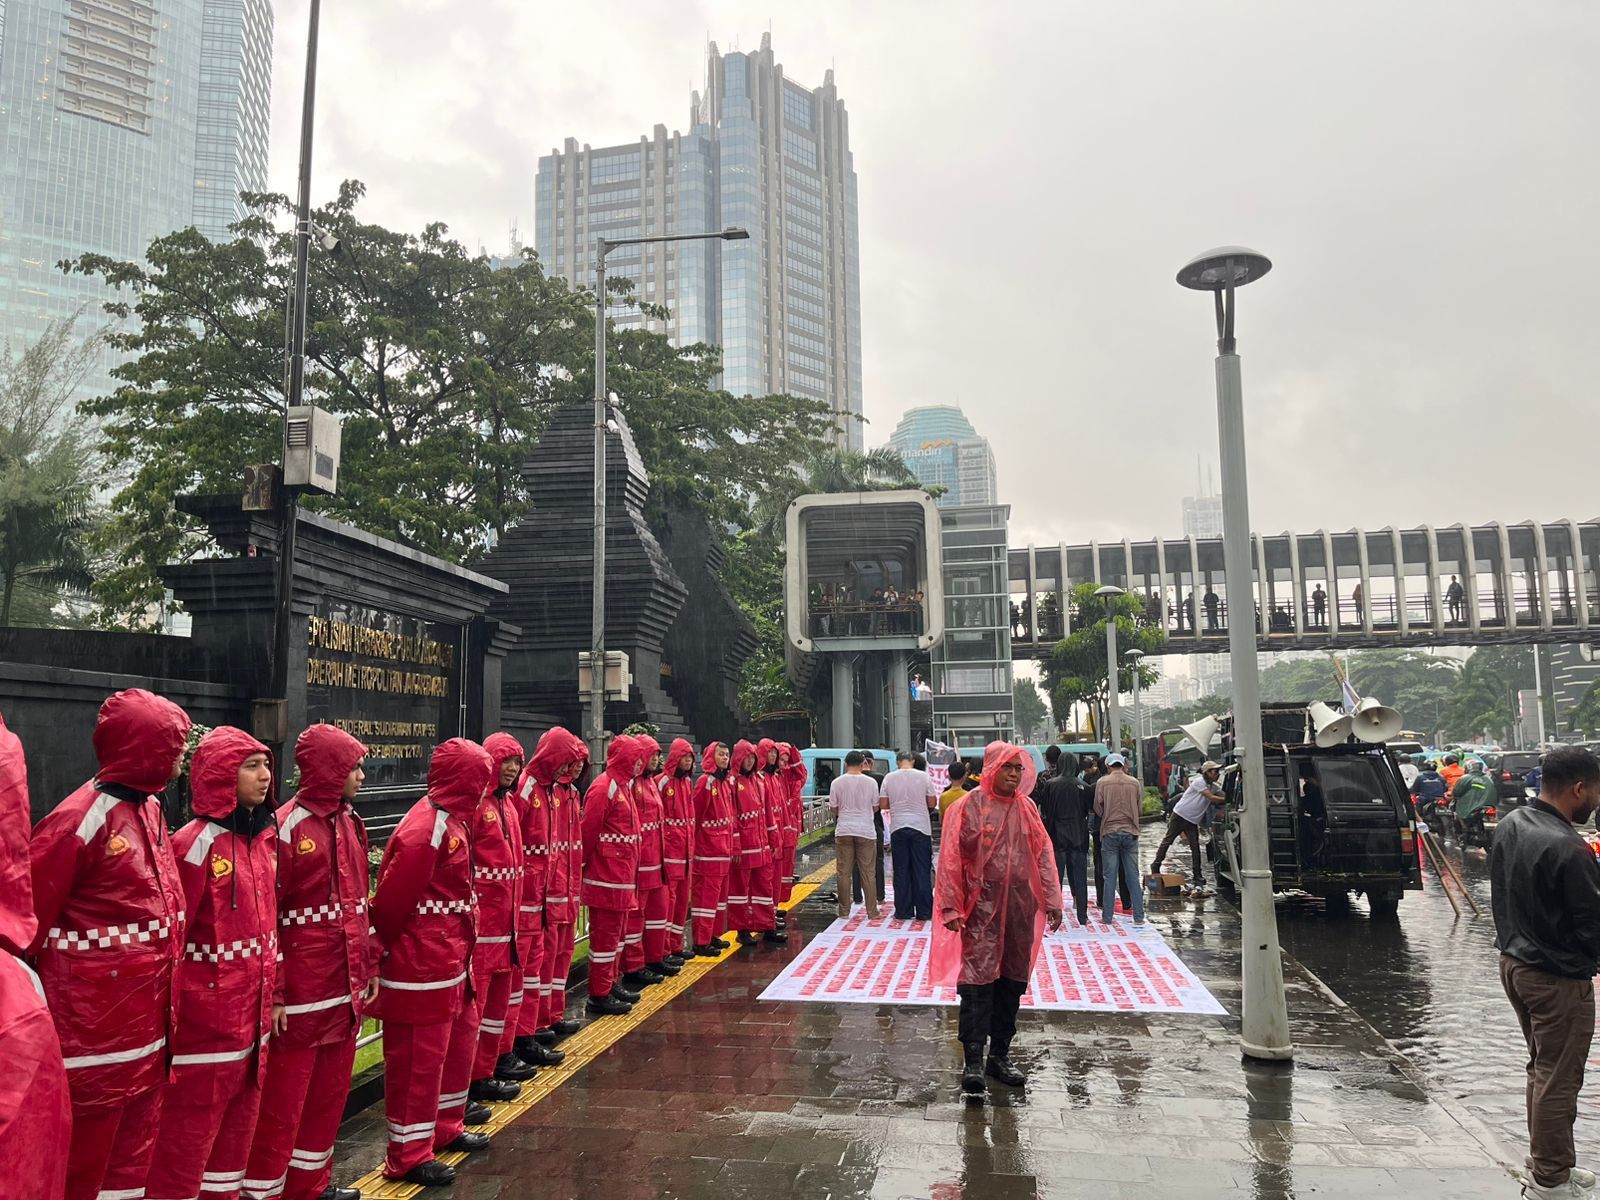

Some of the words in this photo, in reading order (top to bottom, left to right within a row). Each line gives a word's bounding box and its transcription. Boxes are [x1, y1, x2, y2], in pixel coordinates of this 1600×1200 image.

[308, 614, 352, 652] EPOLISIAN
[306, 658, 343, 687] DAERAH
[344, 662, 402, 693] METROPOLITAN
[929, 767, 950, 779] STO
